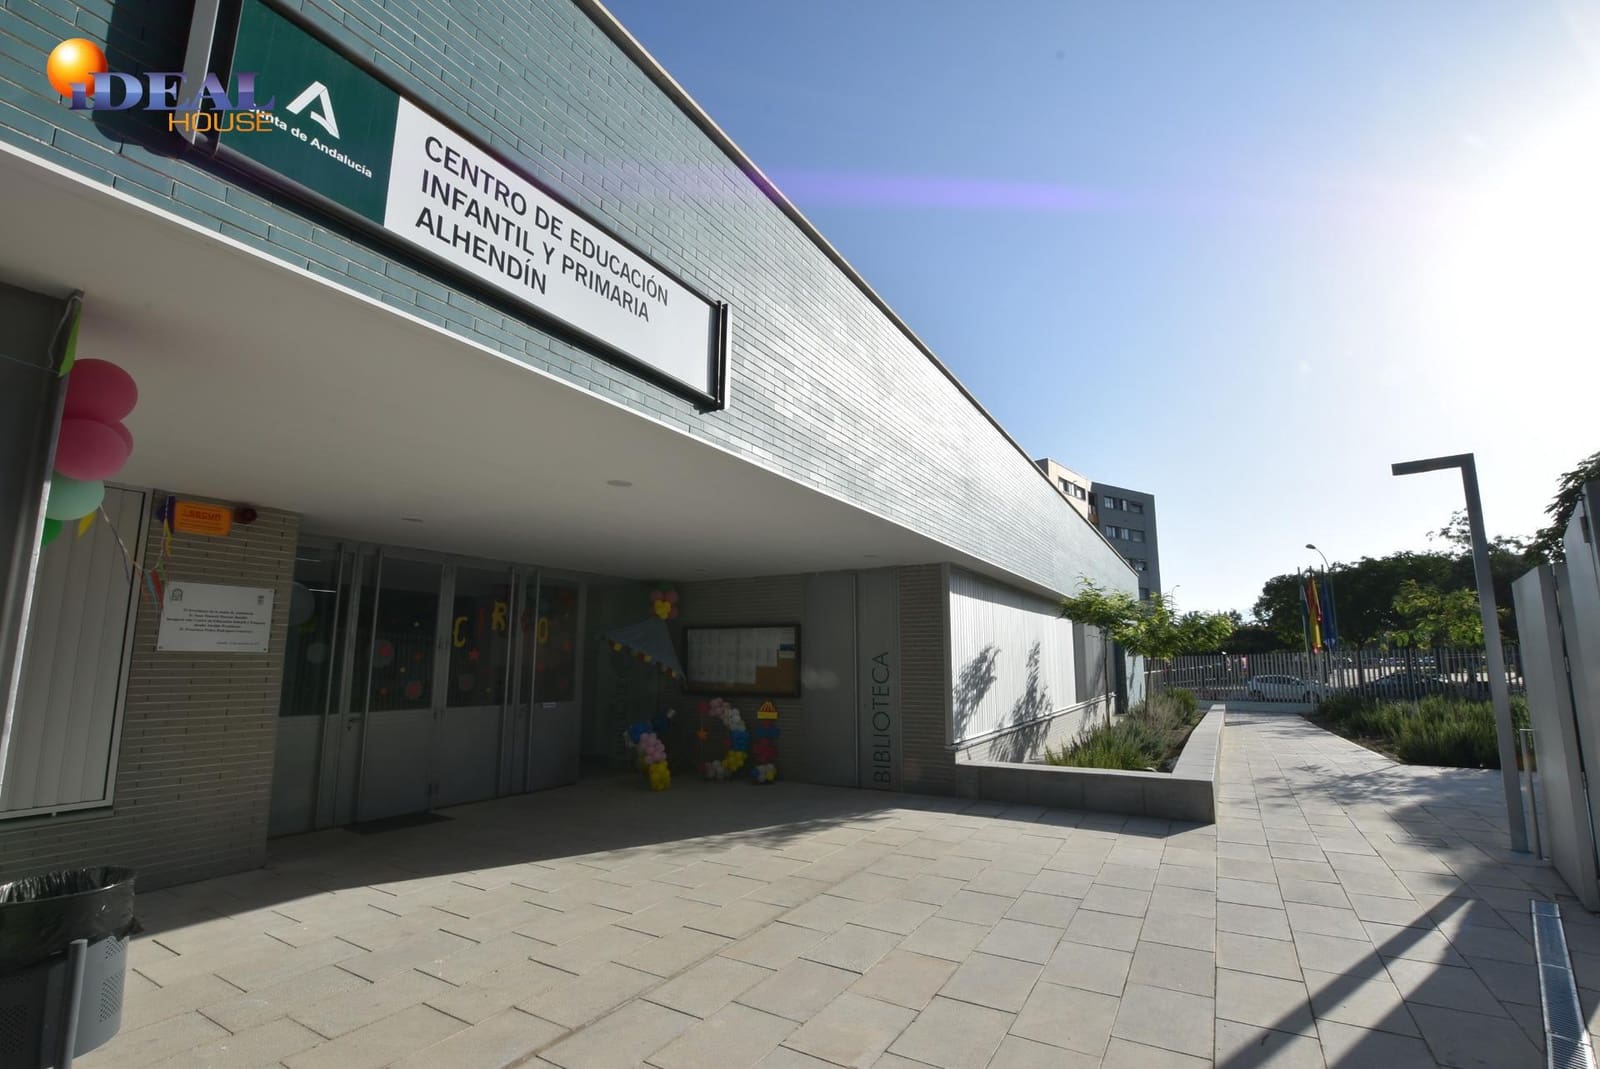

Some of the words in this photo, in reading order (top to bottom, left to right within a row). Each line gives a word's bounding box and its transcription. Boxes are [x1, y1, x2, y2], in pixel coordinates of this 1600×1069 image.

[290, 127, 308, 142] de
[310, 138, 374, 179] Andalucía
[415, 207, 547, 295] ALHENDÍN
[421, 169, 535, 256] INFANTIL
[542, 241, 556, 266] Y
[561, 254, 650, 323] PRIMARIA
[424, 136, 528, 216] CENTRO
[535, 205, 564, 241] DE
[570, 228, 669, 307] EDUCACIÓN
[872, 651, 891, 784] BIBLIOTECA
